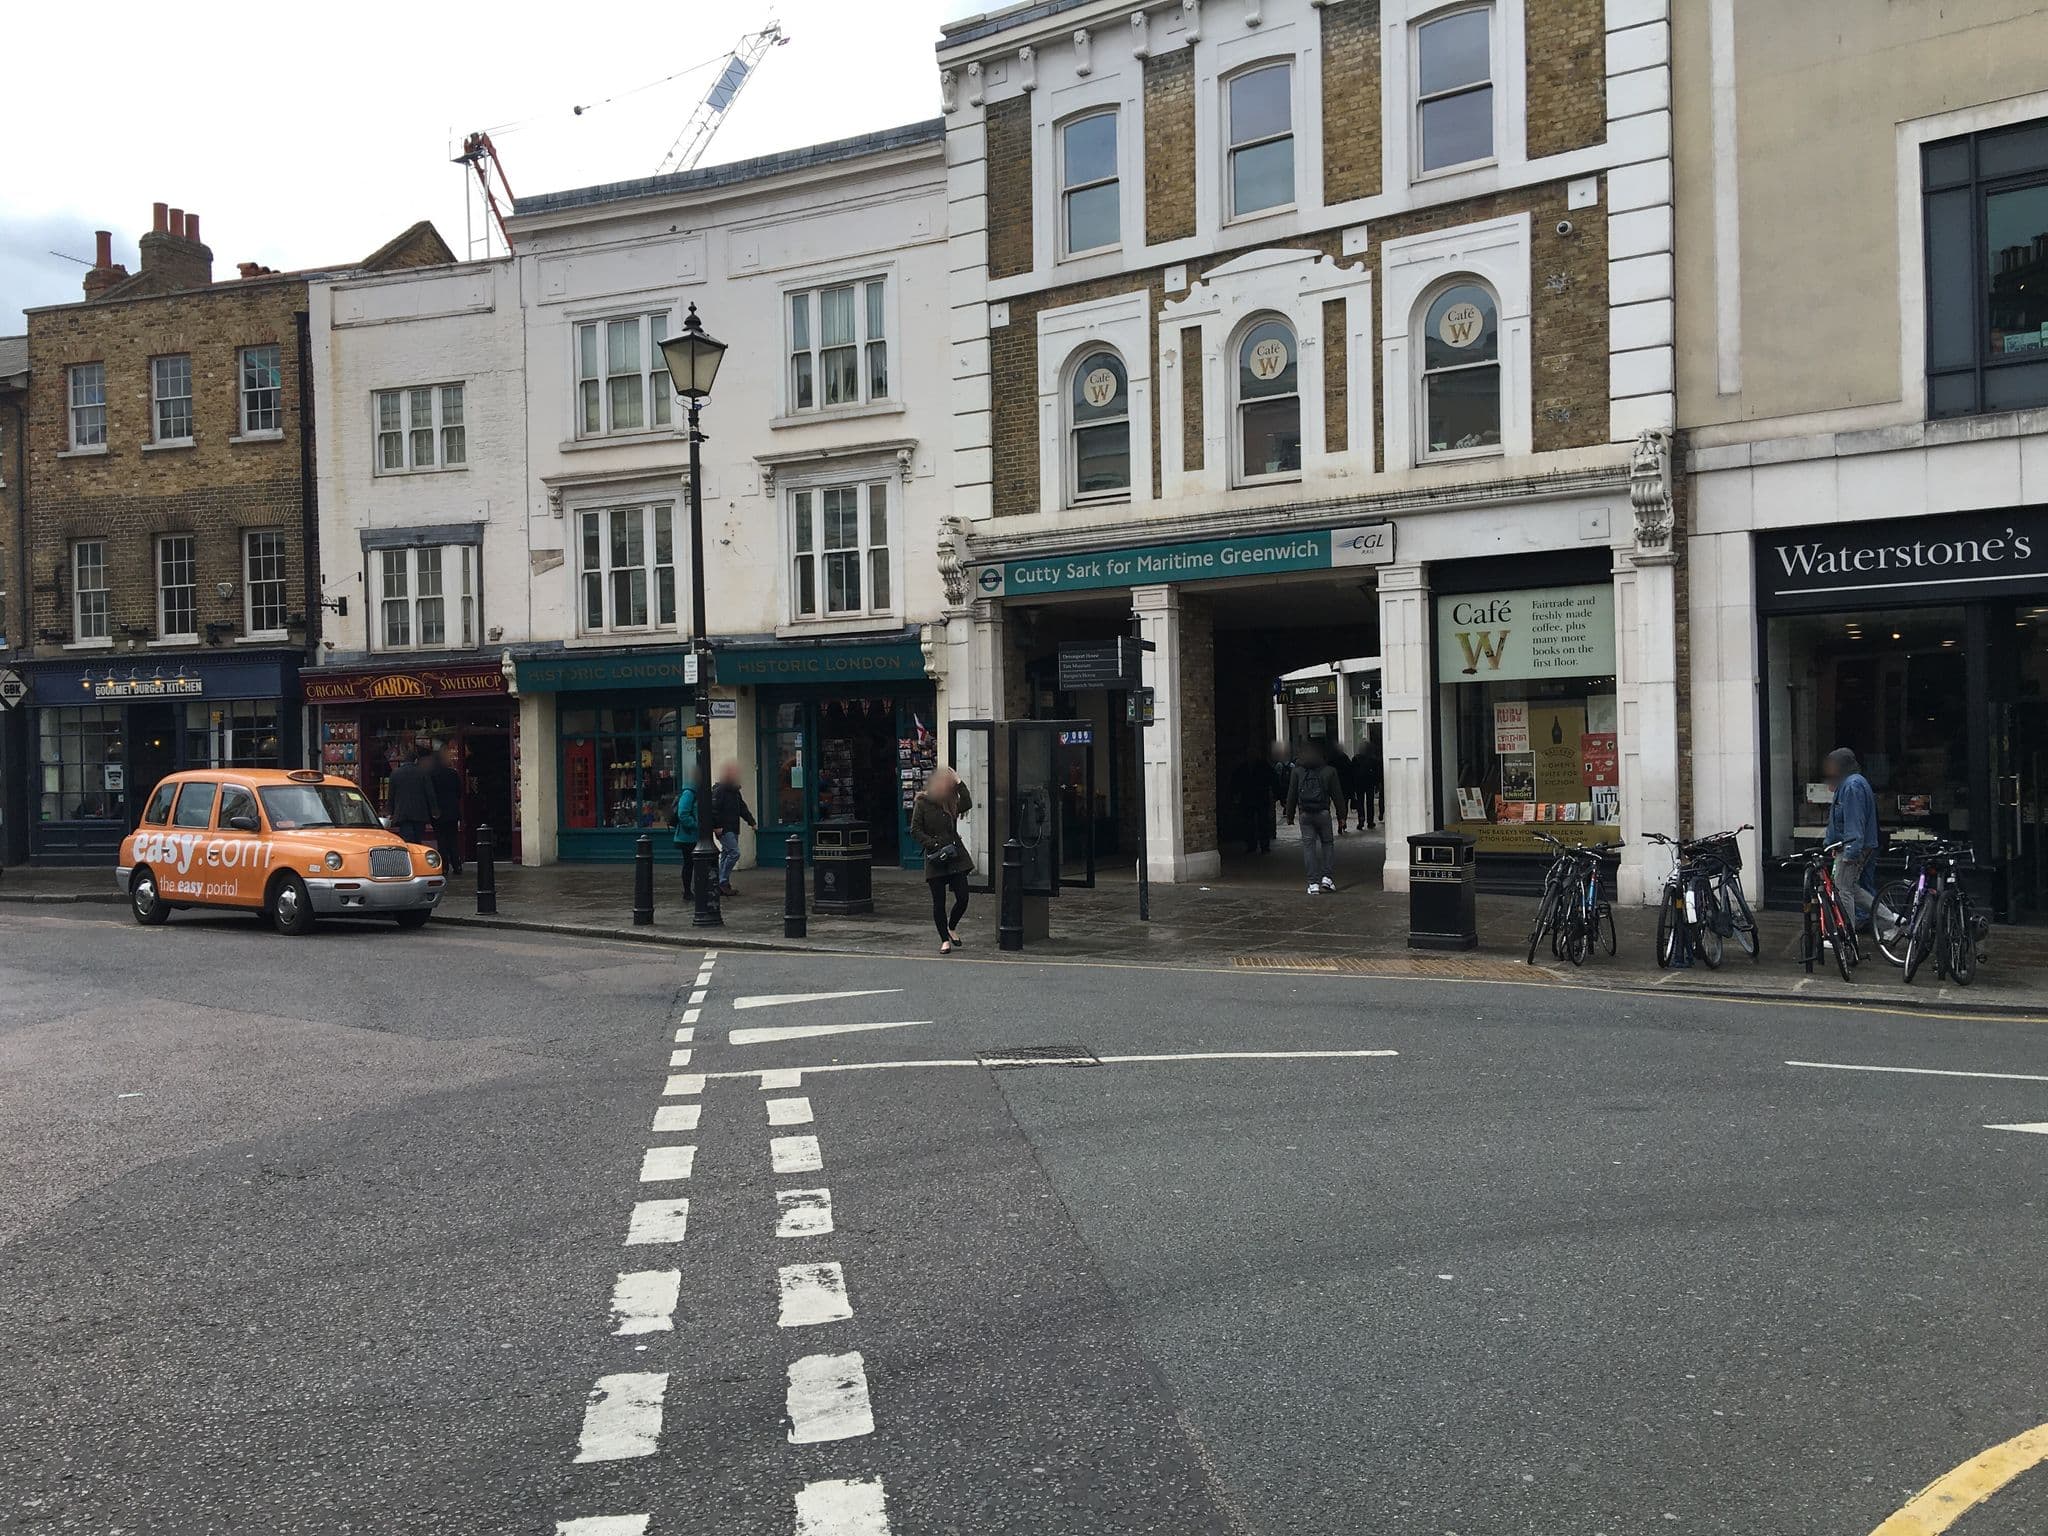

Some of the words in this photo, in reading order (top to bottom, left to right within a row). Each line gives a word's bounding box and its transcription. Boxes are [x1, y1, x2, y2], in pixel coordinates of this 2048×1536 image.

[1448, 307, 1475, 321] Café
[1449, 321, 1474, 343] W
[1256, 345, 1281, 357] Café
[1258, 356, 1278, 376] W
[1089, 373, 1112, 384] Café
[1091, 383, 1109, 403] W
[1352, 534, 1384, 550] CGL
[1775, 527, 2032, 577] Waterstone's
[1014, 568, 1061, 584] Cutty
[1066, 561, 1101, 579] Sark
[1106, 559, 1131, 575] for
[1137, 552, 1214, 573] Maritime
[1220, 540, 1319, 565] Greenwich
[1532, 599, 1575, 610] Fairtrade
[1577, 596, 1596, 606] and
[1453, 600, 1512, 626] Café
[1532, 610, 1562, 622] freshly
[1566, 609, 1592, 619] made
[1532, 623, 1563, 633] coffee,
[1565, 622, 1586, 634] plus
[1532, 636, 1558, 646] many
[1455, 630, 1511, 672] W
[1533, 646, 1560, 656] books
[1562, 647, 1575, 655] on
[1578, 644, 1594, 653] the
[738, 659, 819, 673] HISTORIC
[825, 655, 900, 671] LONDON
[1533, 657, 1552, 668] first
[1554, 657, 1579, 667] floor.
[528, 667, 606, 682] HISTORIC
[612, 664, 682, 679] LONDON
[4, 684, 21, 694] GBK
[95, 685, 132, 696] GOURMET
[133, 683, 165, 695] BURGER
[166, 681, 202, 693] KITCHEN
[306, 683, 355, 698] ORIGINAL
[374, 676, 421, 697] HARDYS
[440, 674, 501, 691] SWEETSHOP
[133, 832, 273, 874] easy.com
[1416, 870, 1454, 878] LITTER
[159, 875, 175, 891] the
[177, 881, 203, 897] easy
[206, 878, 238, 898] portal
